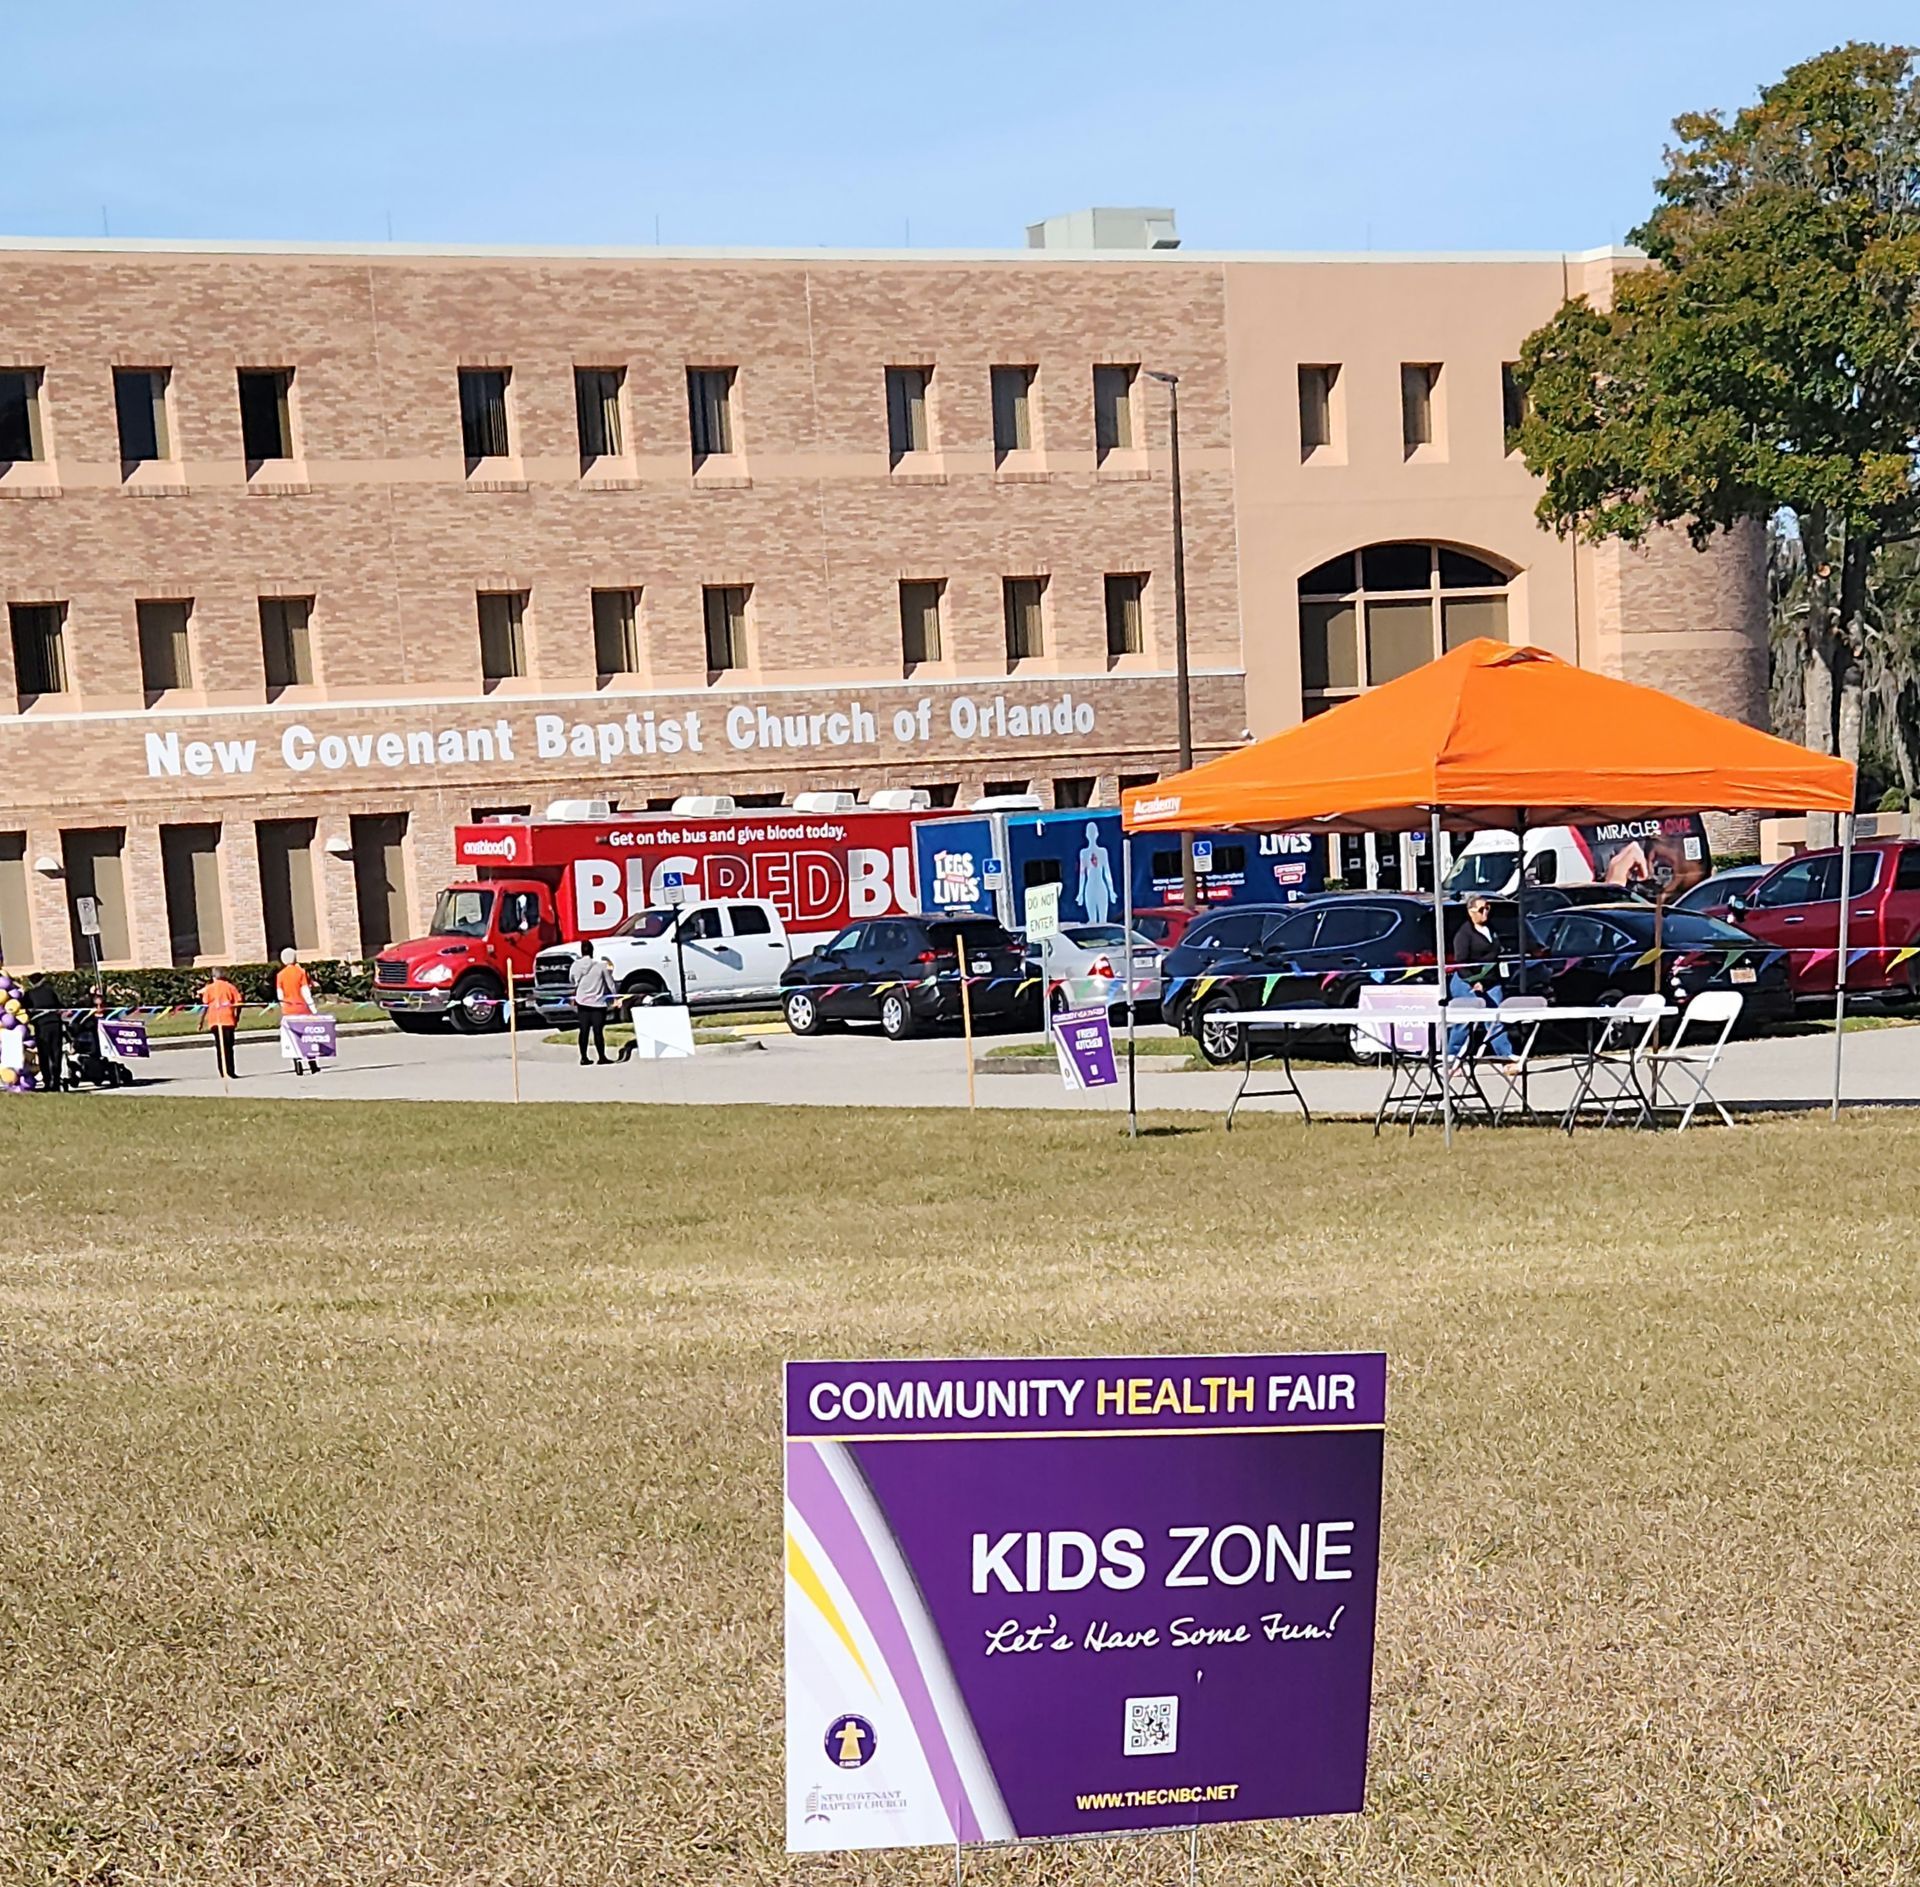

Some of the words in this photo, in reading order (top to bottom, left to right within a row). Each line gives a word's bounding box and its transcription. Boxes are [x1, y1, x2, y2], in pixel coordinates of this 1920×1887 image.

[144, 731, 257, 777] New
[281, 719, 515, 772] Covenant
[535, 711, 703, 765] Baptist
[725, 702, 876, 750] Church
[893, 698, 932, 742] of
[950, 694, 1095, 739] Orlando
[1133, 796, 1182, 815] Academy
[609, 830, 635, 846] Get
[636, 832, 655, 845] on
[656, 829, 681, 844] the
[682, 827, 707, 843] bus
[709, 825, 736, 842] and
[737, 826, 765, 845] give
[766, 823, 804, 840] blood
[806, 822, 848, 842] today.
[1596, 820, 1653, 841] MIRACLE
[1259, 833, 1312, 855] LIVES
[933, 877, 979, 904] LIVES
[1028, 896, 1039, 910] DO
[1040, 893, 1055, 907] NOT
[1030, 916, 1055, 932] ENTER
[808, 1379, 1085, 1422] COMMUNITY
[1096, 1376, 1255, 1416] HEALTH
[1267, 1374, 1357, 1412] FAIR
[972, 1528, 1146, 1594] KIDS
[1165, 1522, 1354, 1587] ZONE
[985, 1614, 1075, 1656] Let's
[1083, 1620, 1160, 1652] Have
[1169, 1617, 1252, 1646] Some
[1260, 1605, 1345, 1640] Fun!
[820, 1801, 862, 1811] BAPTIST
[864, 1799, 907, 1810] CHURCH
[821, 1793, 844, 1801] NEW
[846, 1790, 902, 1801] COVENANT
[1076, 1784, 1239, 1810] WWW.THECNBC.NET
